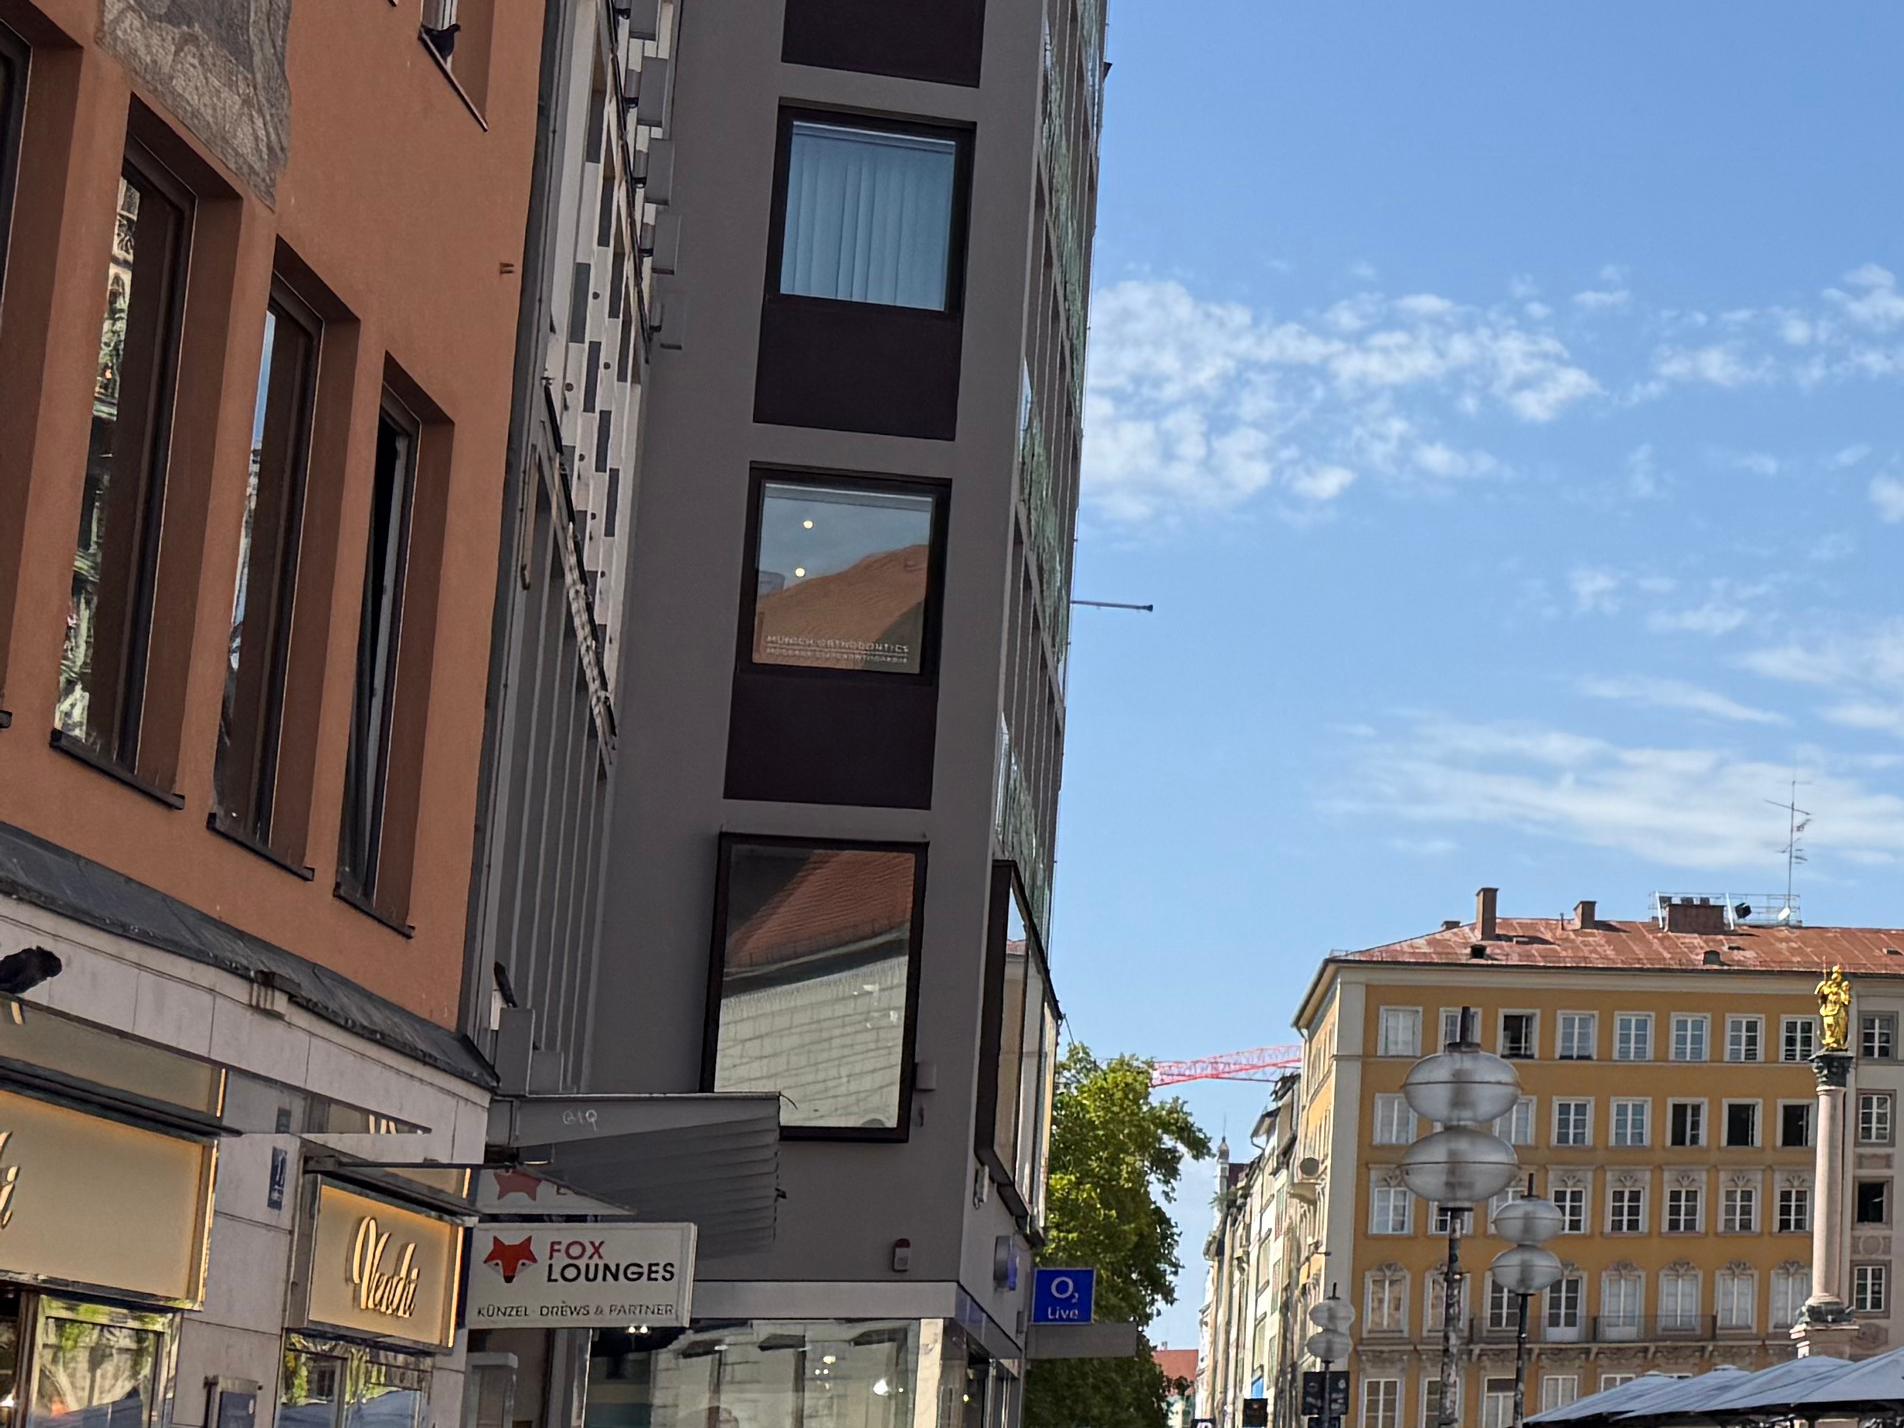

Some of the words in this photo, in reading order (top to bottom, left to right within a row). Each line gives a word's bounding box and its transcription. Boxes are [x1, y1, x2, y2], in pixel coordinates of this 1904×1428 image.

[549, 1241, 605, 1261] FOX
[546, 1263, 675, 1283] LOUNGES
[477, 1304, 530, 1317] KÜNZEL
[609, 1304, 673, 1316] PARTNER
[1048, 1306, 1078, 1319] Live
